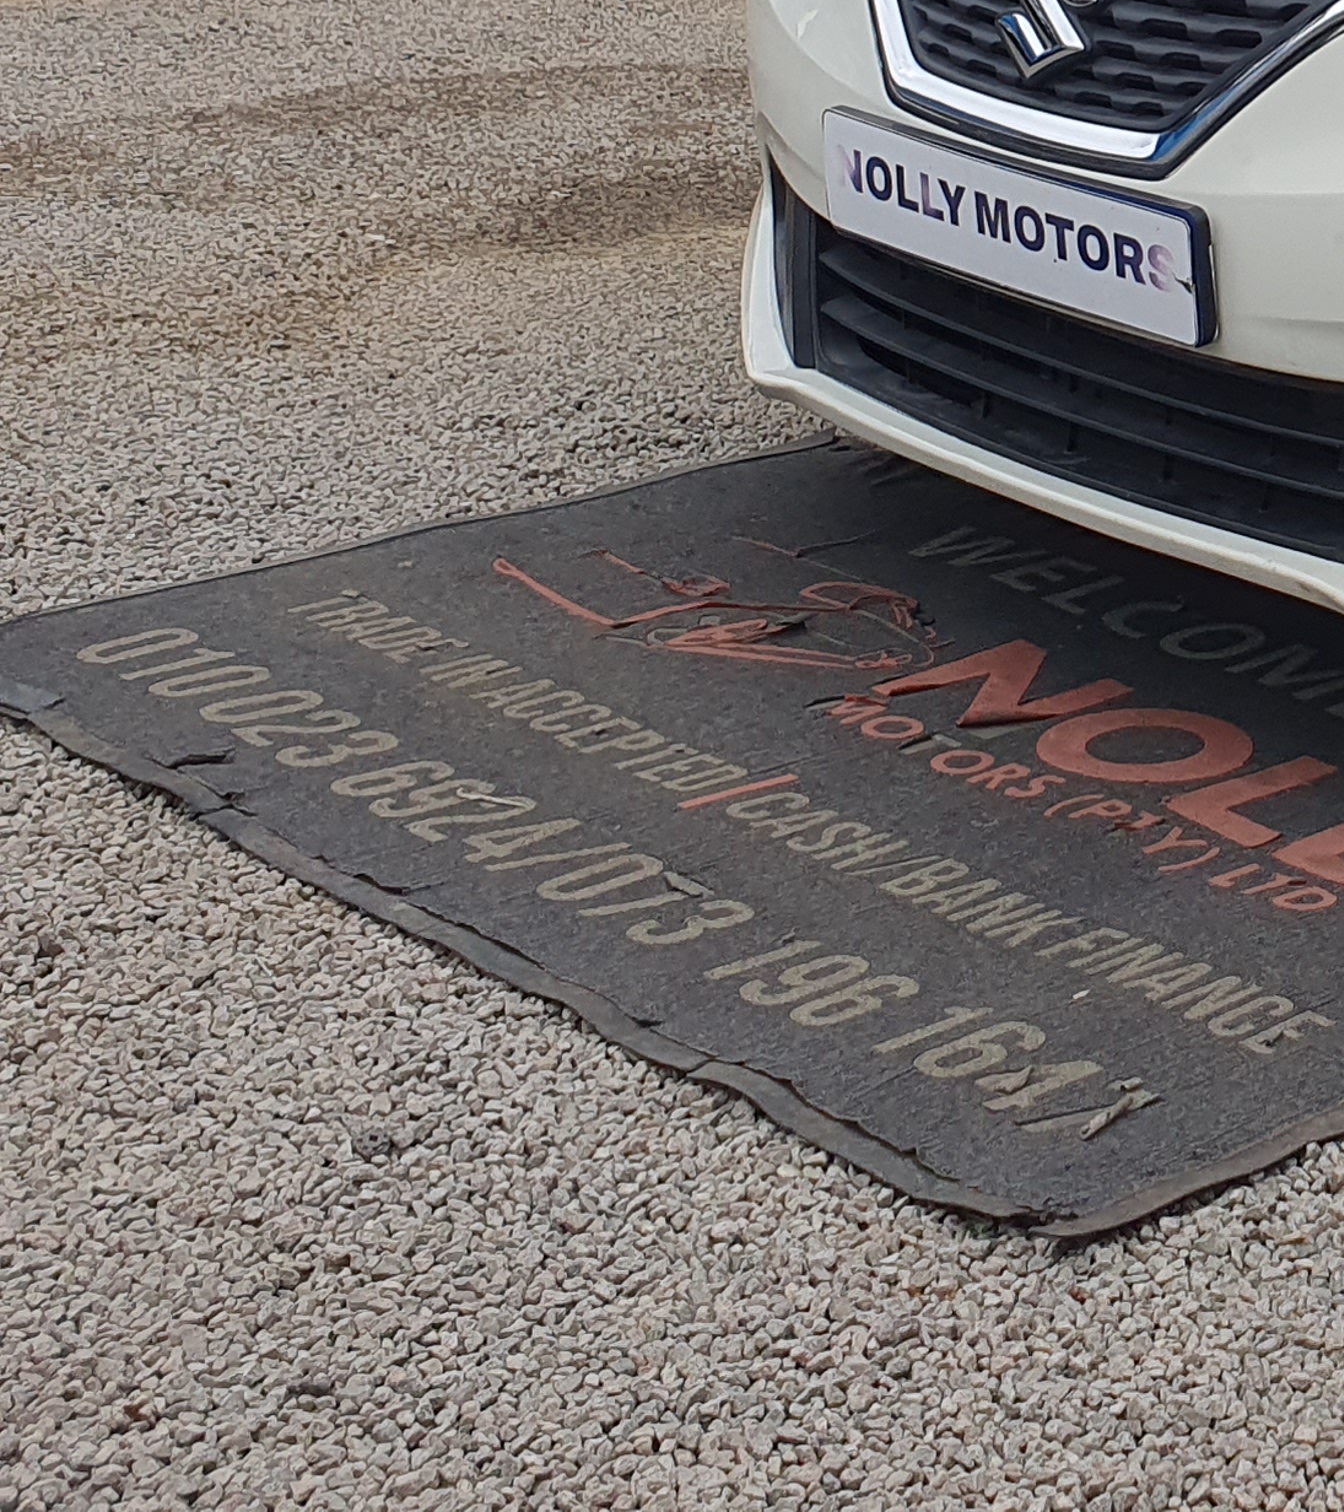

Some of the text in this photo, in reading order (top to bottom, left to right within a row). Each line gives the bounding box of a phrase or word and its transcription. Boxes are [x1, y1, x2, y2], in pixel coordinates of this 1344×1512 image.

[974, 190, 1178, 293] MOTORS
[76, 628, 270, 698] 010
[199, 689, 399, 769] 023
[702, 938, 919, 1027] 196
[288, 589, 470, 663] TRADE
[419, 654, 524, 694] IN
[1037, 926, 1336, 1056] FINANCE
[1207, 863, 1338, 912] LTD
